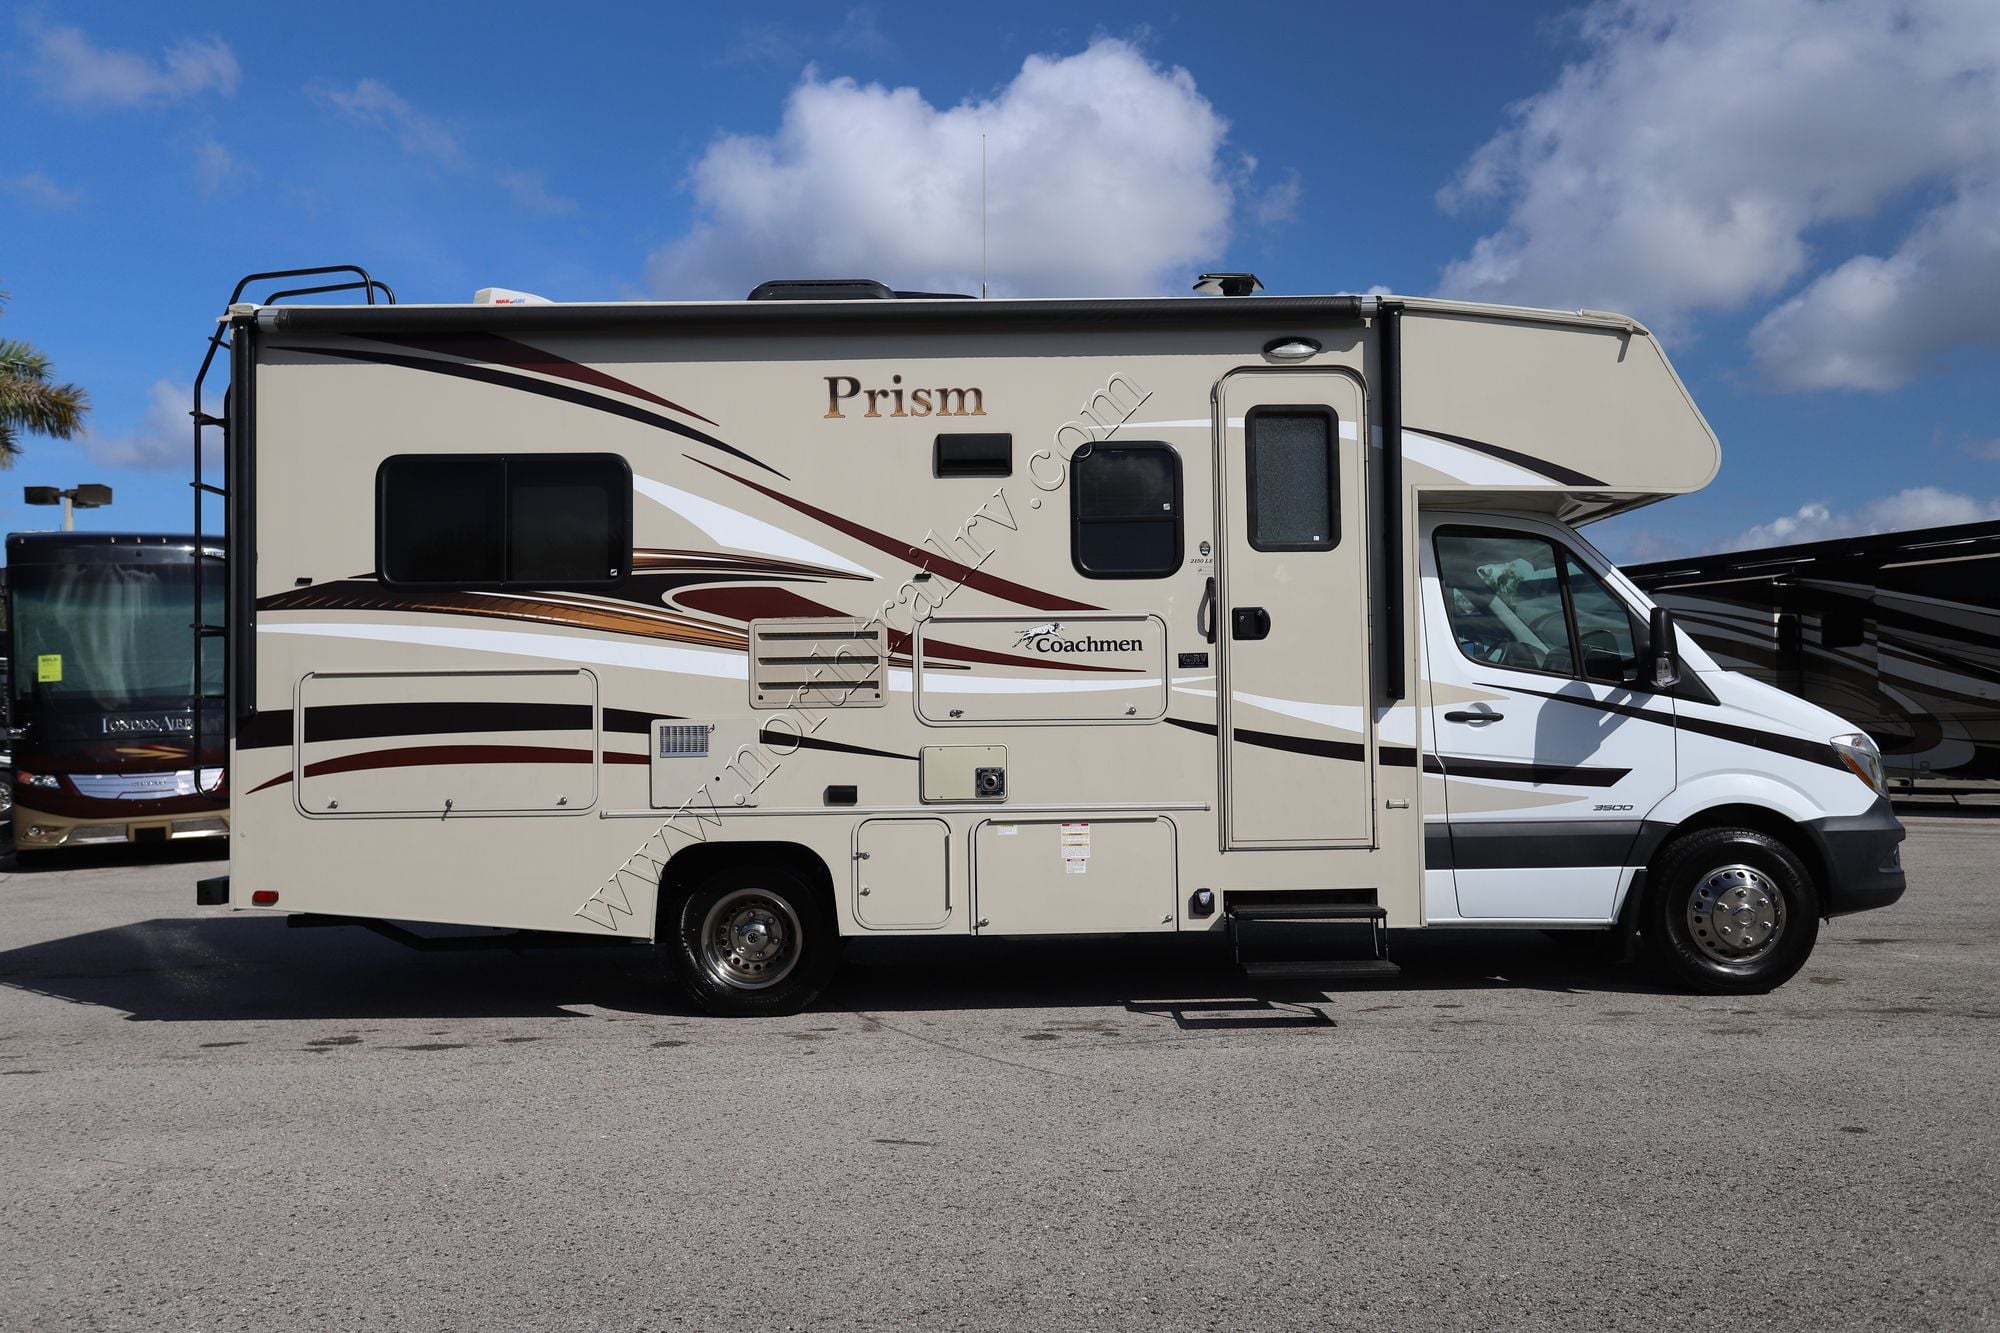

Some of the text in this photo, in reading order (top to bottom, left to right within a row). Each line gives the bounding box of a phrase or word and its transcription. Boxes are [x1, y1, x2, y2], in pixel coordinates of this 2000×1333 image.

[823, 373, 987, 419] Prism
[1035, 635, 1143, 653] Coachmen
[1592, 804, 1634, 812] 3500
